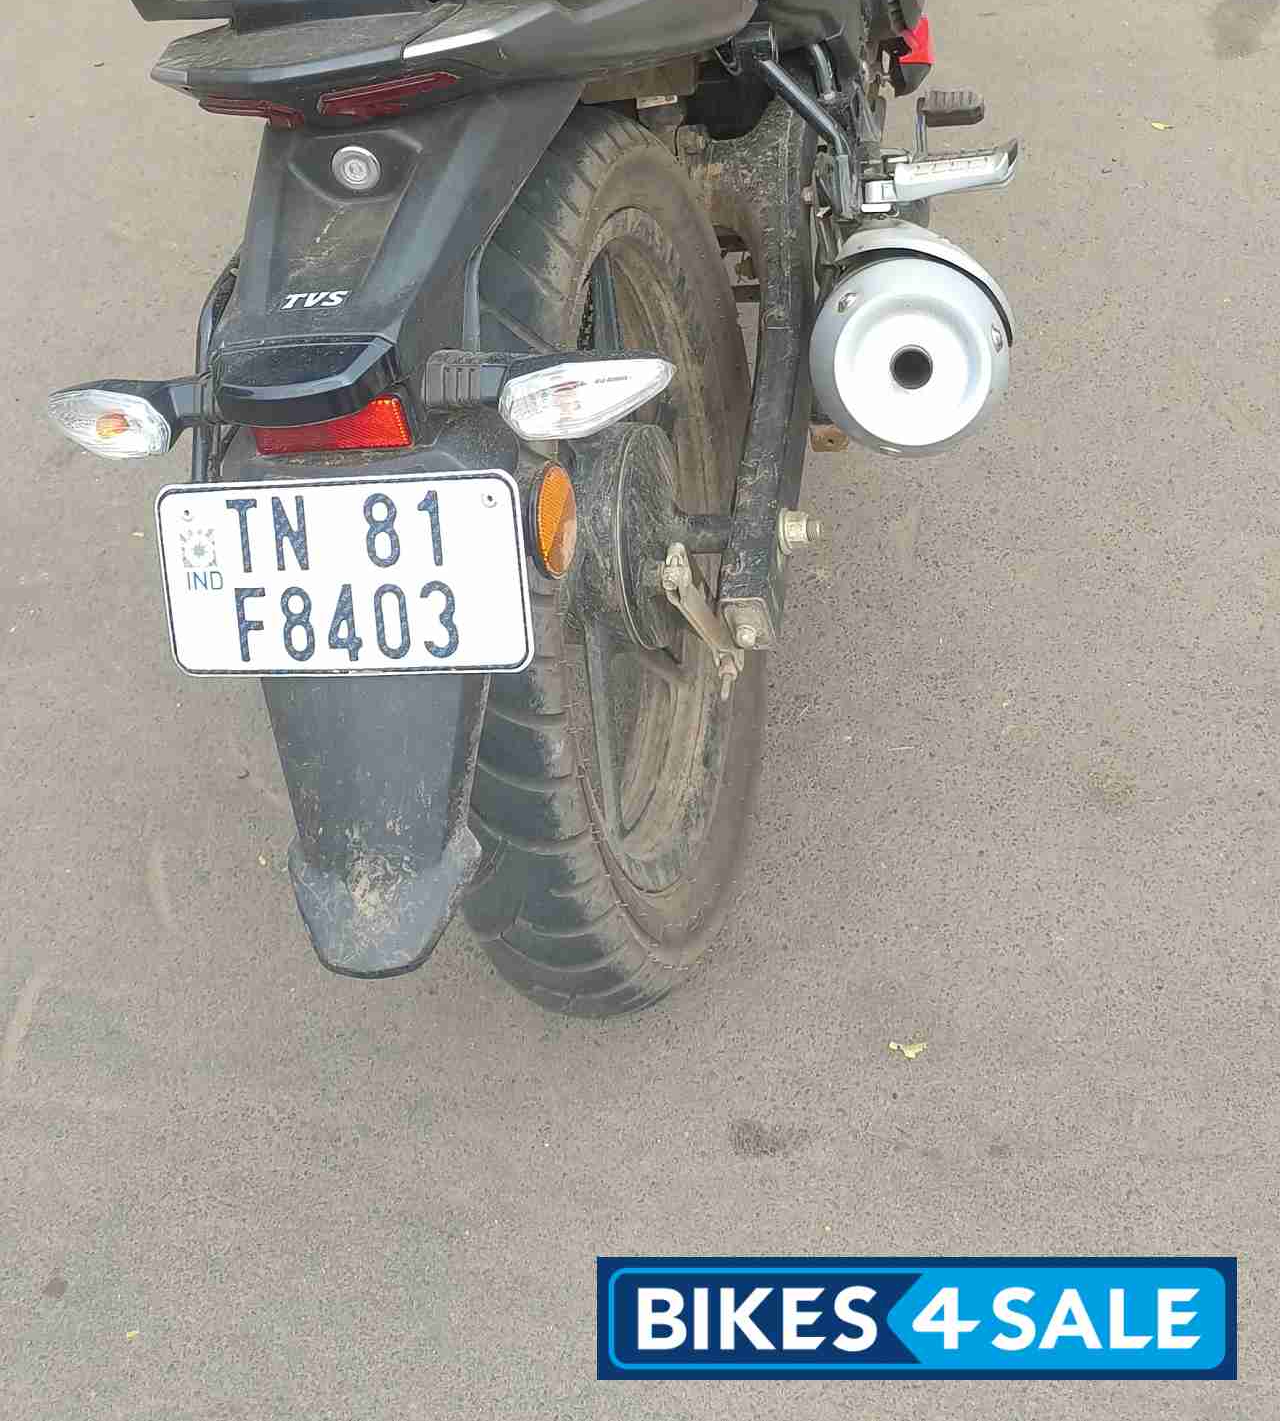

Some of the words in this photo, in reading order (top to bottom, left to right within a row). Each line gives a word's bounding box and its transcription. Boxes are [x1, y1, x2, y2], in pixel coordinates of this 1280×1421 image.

[280, 290, 350, 310] TVS
[225, 495, 310, 573] TN
[362, 490, 443, 568] 81
[186, 571, 224, 591] IND
[234, 580, 459, 662] F8403
